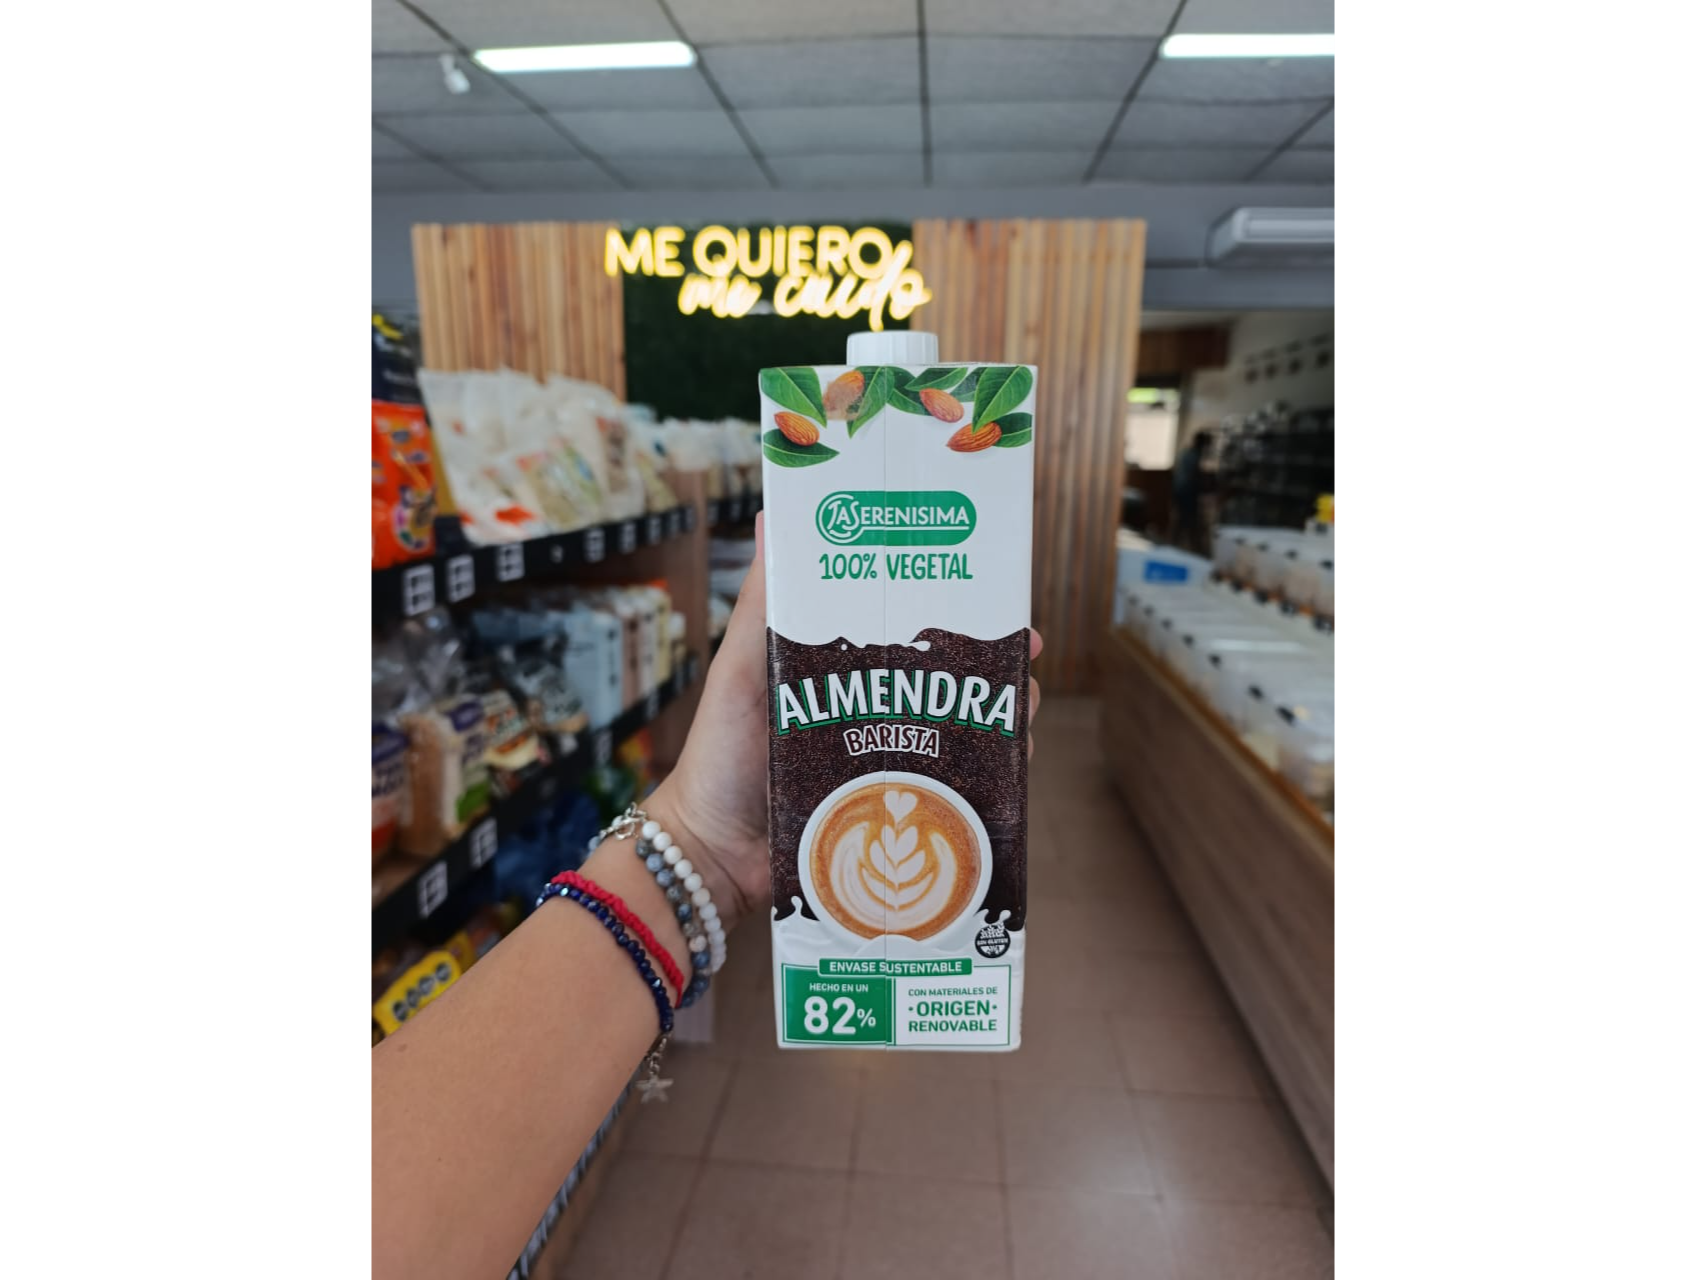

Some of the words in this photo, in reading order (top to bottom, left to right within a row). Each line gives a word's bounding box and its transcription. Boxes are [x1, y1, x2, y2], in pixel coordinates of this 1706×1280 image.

[604, 226, 686, 277] ME
[692, 225, 894, 280] QUIERO
[819, 552, 878, 580] 100%
[886, 552, 973, 581] VEGETAL
[777, 668, 1017, 736] ALMENDRA
[843, 723, 940, 758] BARISTA
[829, 961, 876, 973] ENVASE
[879, 960, 963, 974] SUSTENTABLE
[809, 982, 840, 993] HECHO
[841, 982, 855, 993] EN
[855, 983, 869, 993] UN
[908, 988, 927, 997] CON
[928, 987, 983, 997] MATERIALES
[986, 986, 998, 995] DE
[803, 995, 877, 1035] 82%
[908, 1019, 997, 1033] RENOVABLE
